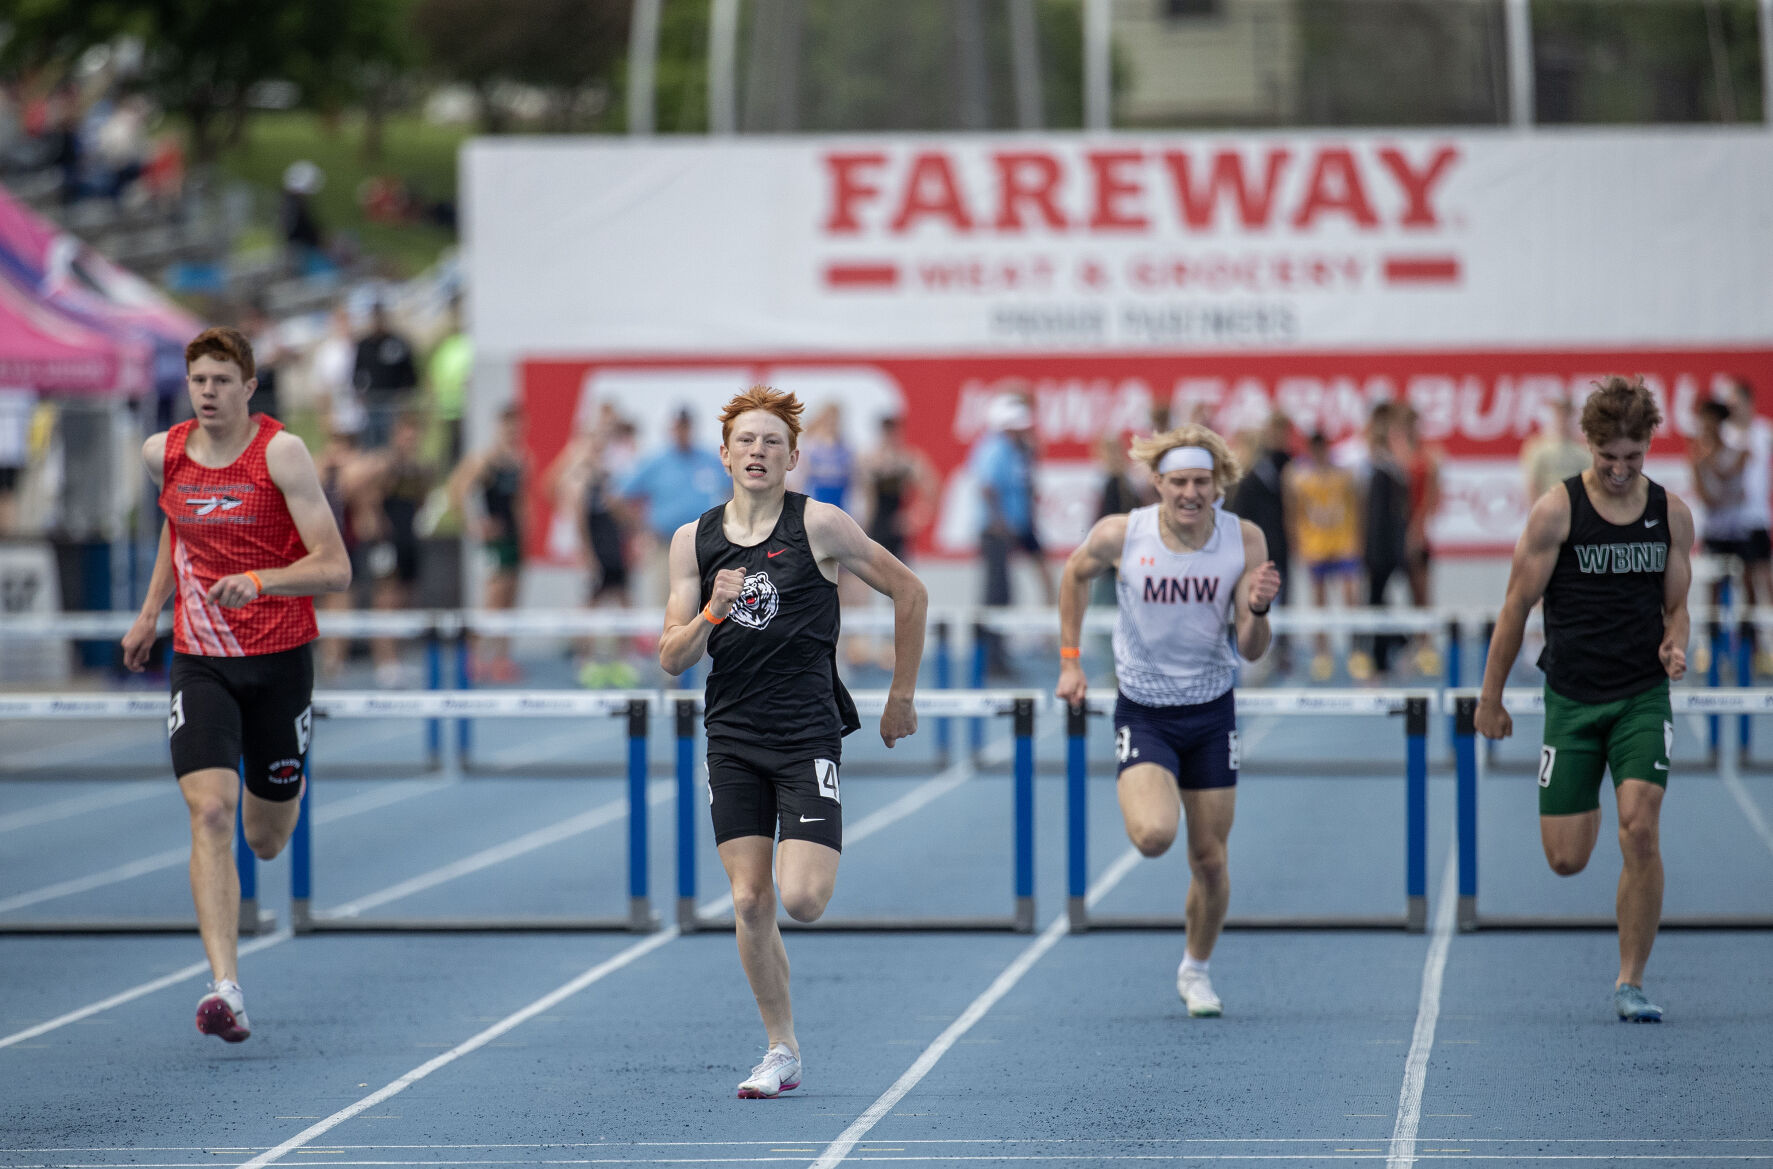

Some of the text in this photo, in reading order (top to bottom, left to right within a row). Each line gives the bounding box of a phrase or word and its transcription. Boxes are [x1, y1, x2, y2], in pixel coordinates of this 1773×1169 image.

[822, 147, 1462, 234] FAREWAY
[954, 378, 1153, 440] IWA
[1574, 541, 1668, 574] WBND
[1143, 576, 1220, 603] MNW
[823, 762, 839, 800] 4
[1540, 749, 1551, 783] 2
